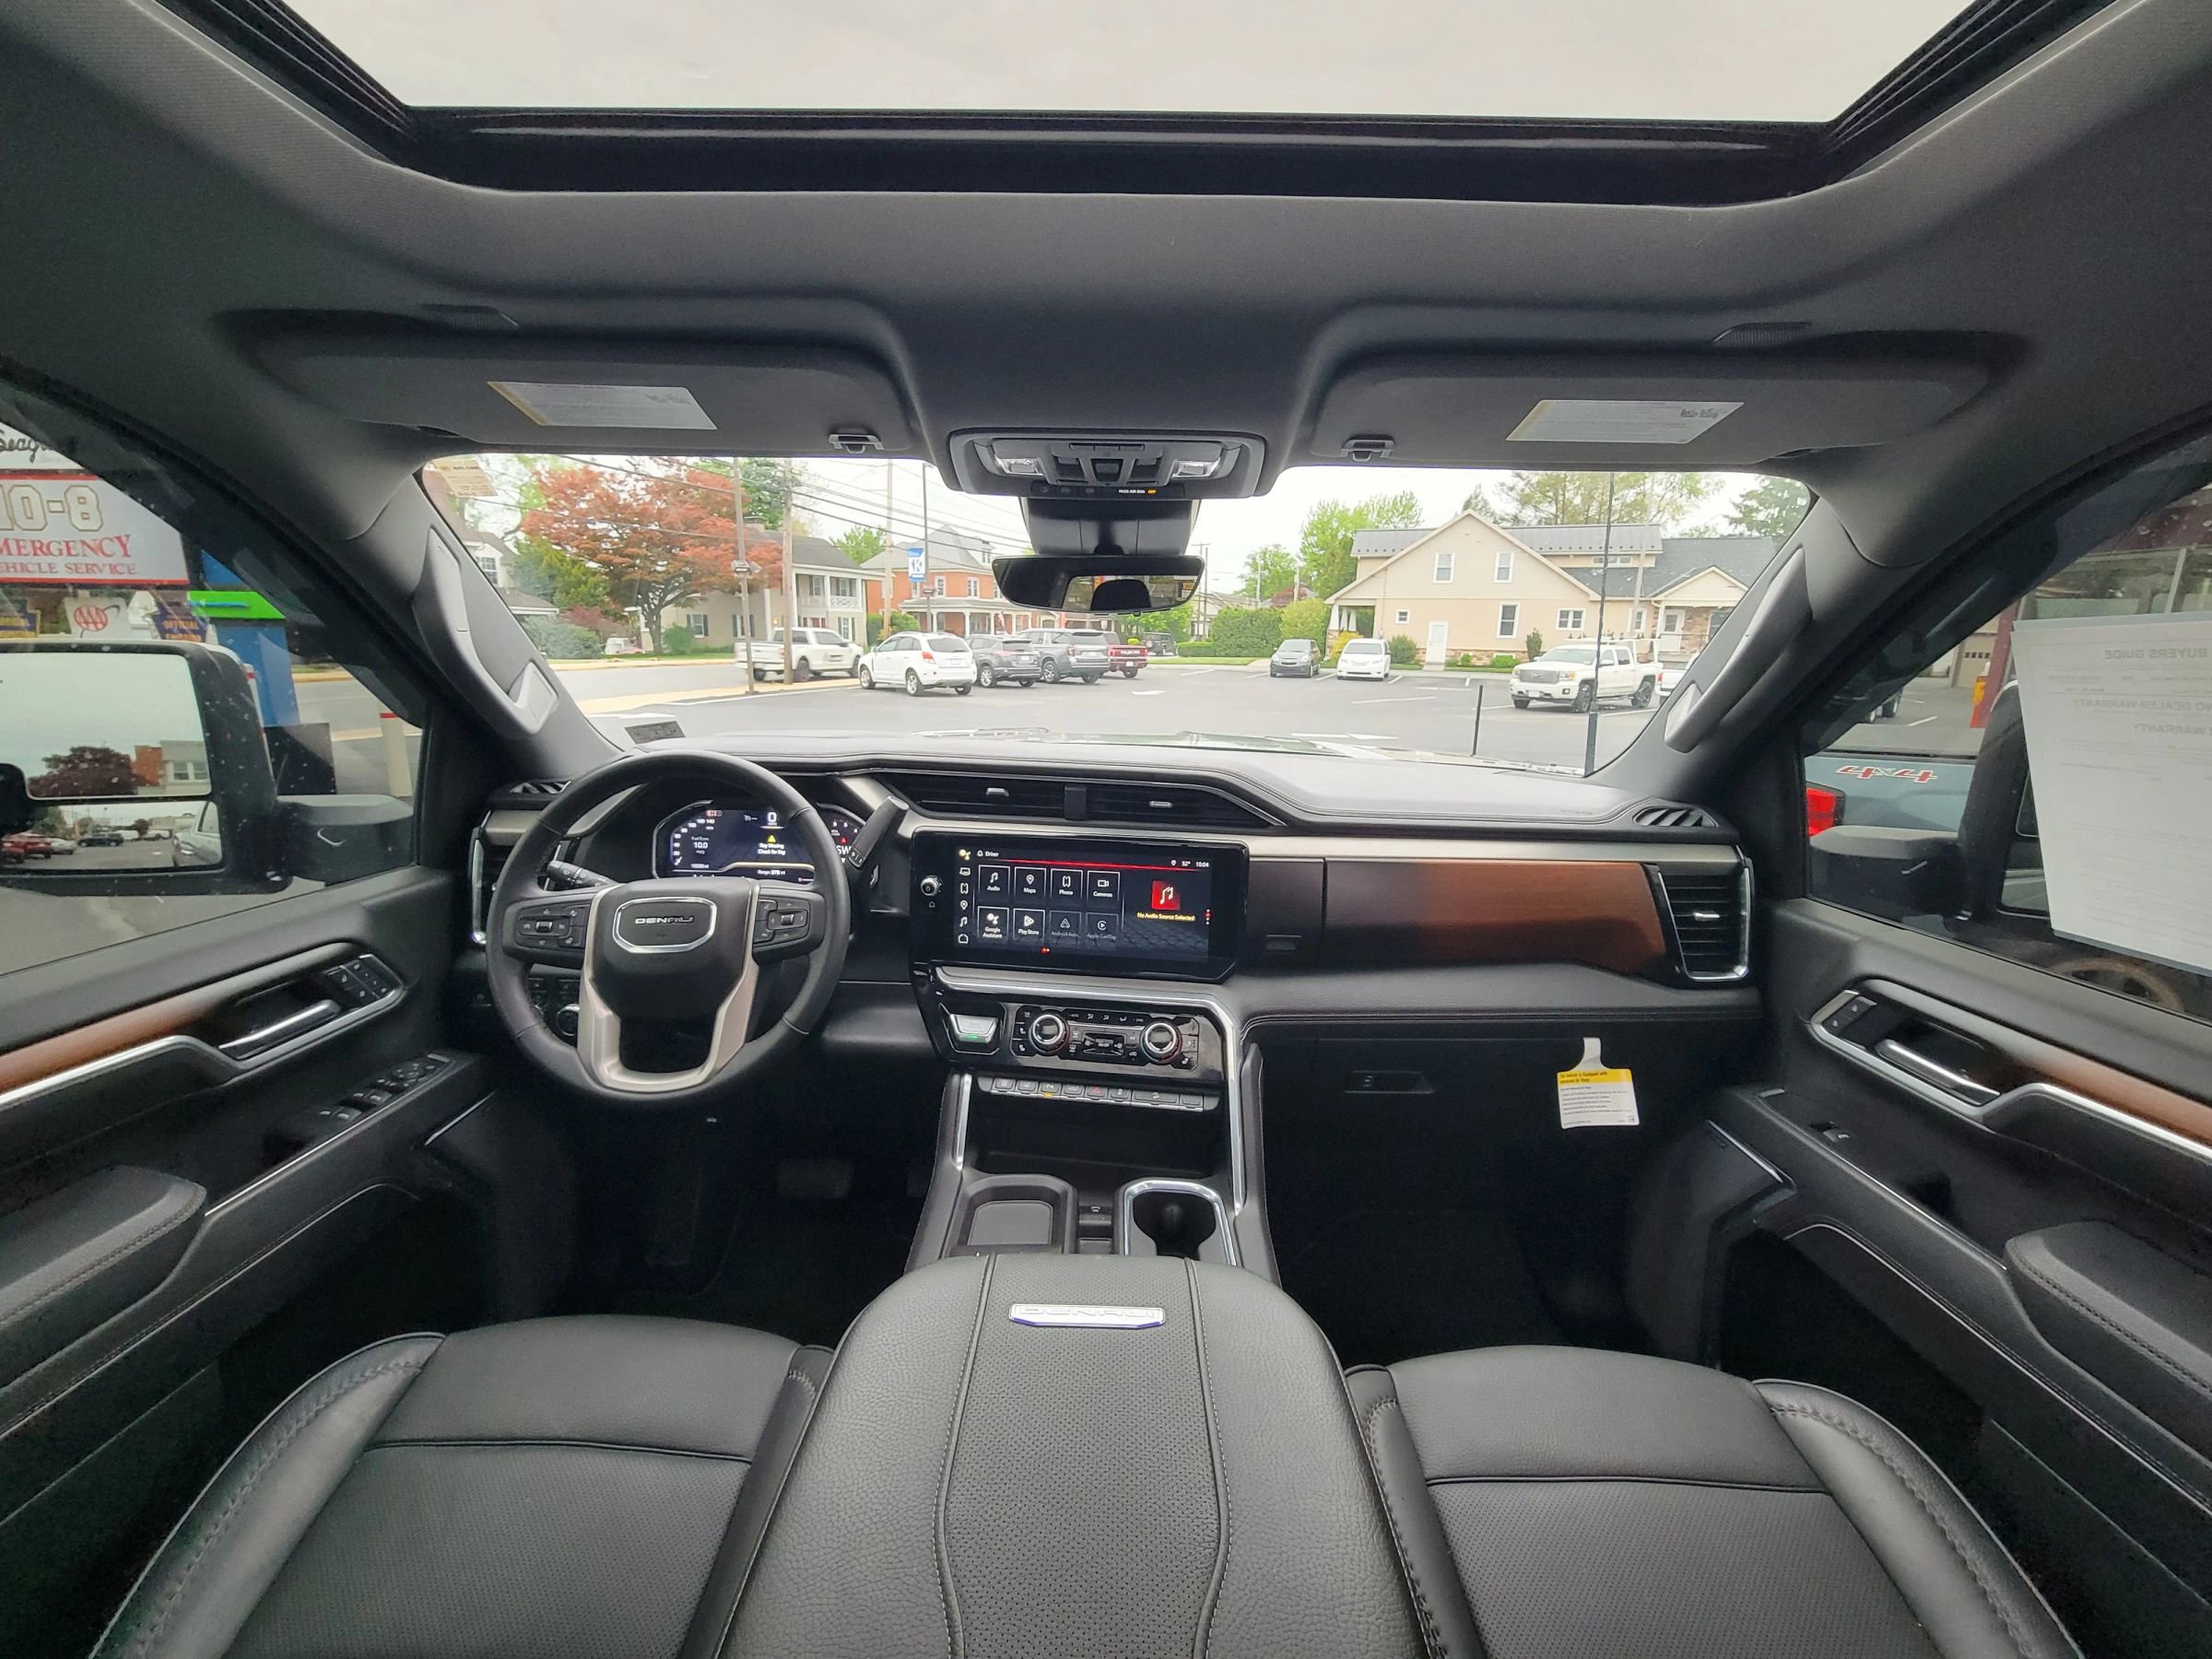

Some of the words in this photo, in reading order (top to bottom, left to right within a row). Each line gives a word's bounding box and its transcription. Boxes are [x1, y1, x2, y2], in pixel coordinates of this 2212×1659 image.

[65, 562, 137, 575] SERVICE
[76, 606, 107, 630] AAA
[635, 916, 694, 924] DENALI
[1100, 933, 1116, 941] CarPlay
